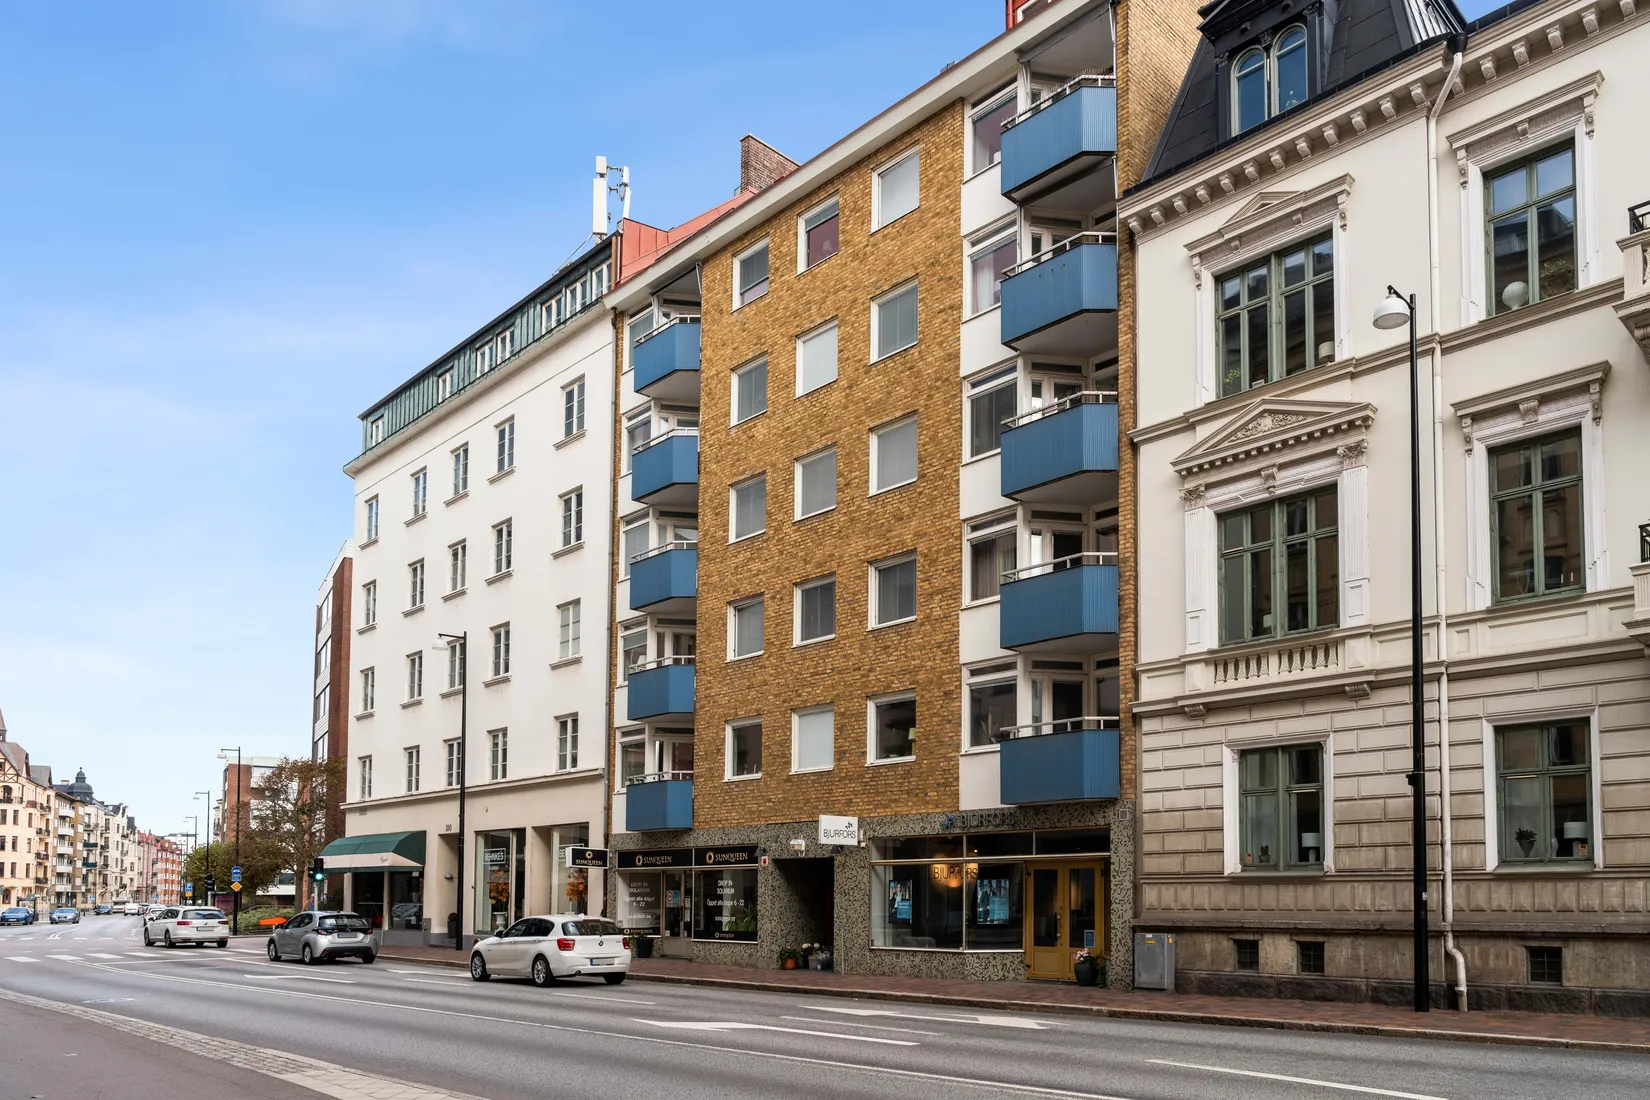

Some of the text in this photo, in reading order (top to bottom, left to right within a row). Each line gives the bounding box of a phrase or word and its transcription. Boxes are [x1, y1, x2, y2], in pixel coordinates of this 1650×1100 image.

[961, 812, 1015, 828] BJURFORS
[823, 828, 857, 839] BJURFORS
[643, 856, 672, 864] SUNQUEEN
[715, 852, 749, 862] SUNQUEEN
[933, 866, 978, 881] BJURFORS
[706, 898, 717, 906] Öppet
